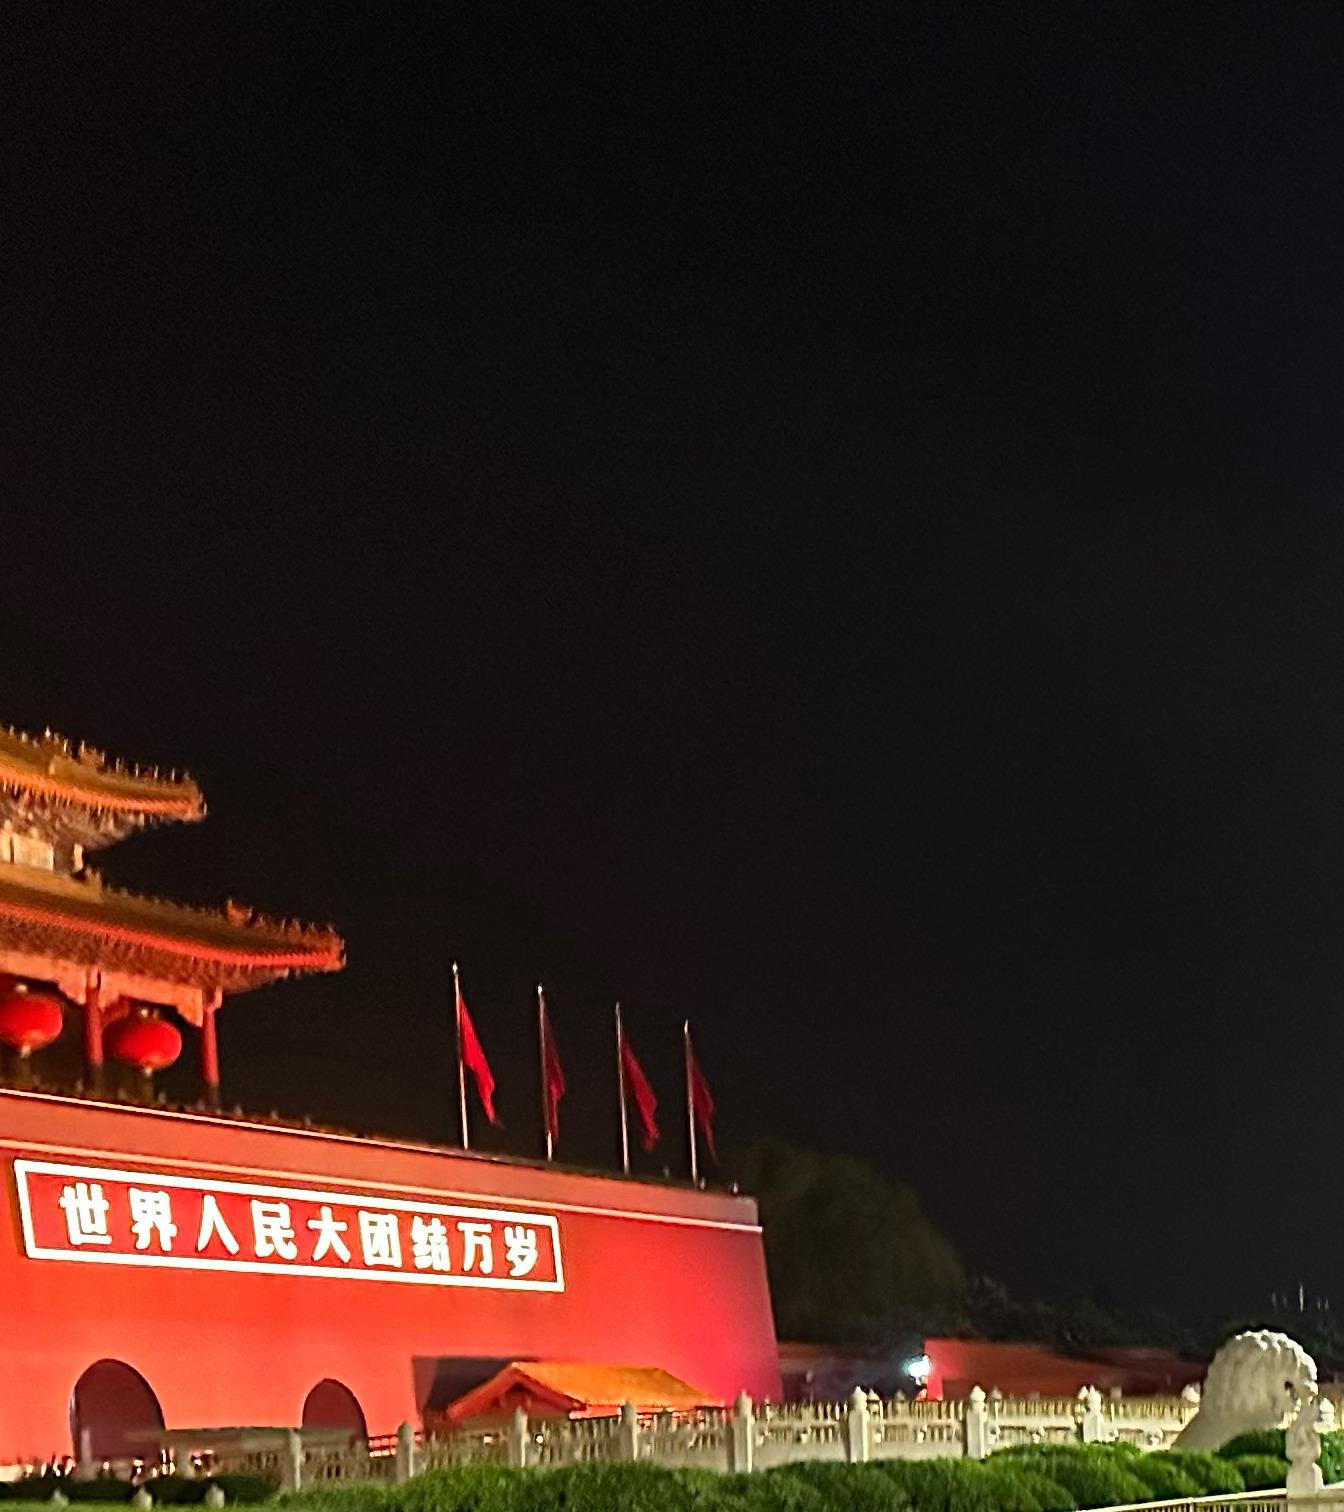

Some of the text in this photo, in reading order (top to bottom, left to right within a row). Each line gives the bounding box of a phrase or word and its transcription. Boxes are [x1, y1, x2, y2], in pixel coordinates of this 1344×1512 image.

[59, 1182, 539, 1278] 世界人民大团结万岁
